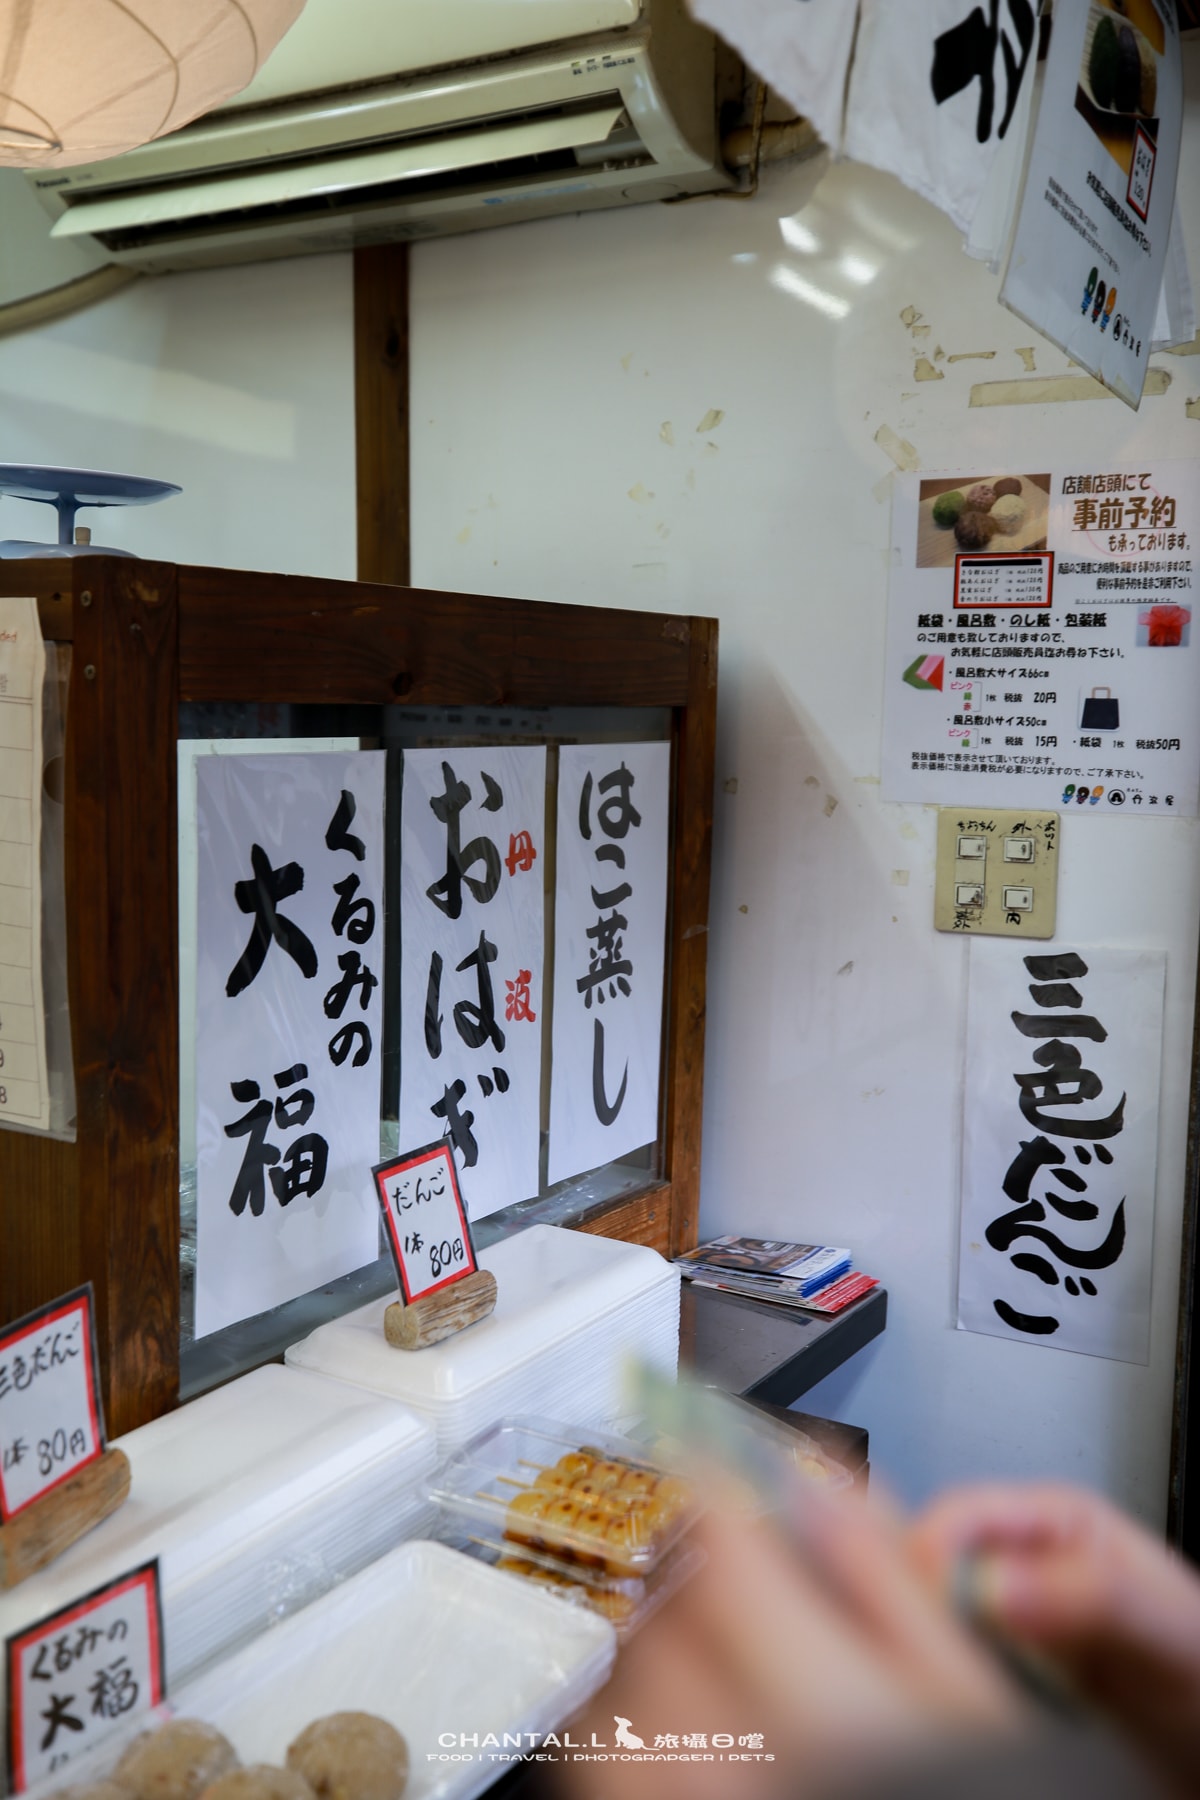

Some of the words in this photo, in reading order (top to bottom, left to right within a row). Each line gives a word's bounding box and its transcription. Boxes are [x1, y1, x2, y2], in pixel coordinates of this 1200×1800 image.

[1062, 473, 1152, 495] 店舗店頭にて
[1072, 496, 1176, 530] 事前予約
[1108, 532, 1191, 552] も承っております。
[917, 613, 1107, 628] 紙袋・風呂敷・のし紙・包装紙
[917, 632, 1065, 644] のご用意も致しておりますので、
[951, 647, 1125, 659] お気軽に店頭販売員迄お尋ね下さい。
[950, 682, 973, 691] ピンク
[1004, 693, 1023, 703] 税抜
[1033, 692, 1057, 704] 20円
[948, 729, 971, 738] ピンク
[1005, 737, 1024, 746] 税抜
[1035, 736, 1058, 748] 15円
[1136, 738, 1180, 751] 税抜50円
[911, 751, 1056, 766] 税抜価格で表示させて頂いております。
[324, 789, 379, 1068] くるみの
[503, 830, 537, 1023] 丹波
[576, 761, 642, 1126] はこ蒸し
[424, 760, 510, 1170] おはぎ
[225, 843, 329, 1217] 大福
[985, 952, 1127, 1335] 三色だんご
[392, 1167, 446, 1216] だんご
[429, 1238, 464, 1278] 80円
[37, 1428, 86, 1476] 80円
[30, 1619, 129, 1682] くるみの
[40, 1656, 139, 1752] 大福
